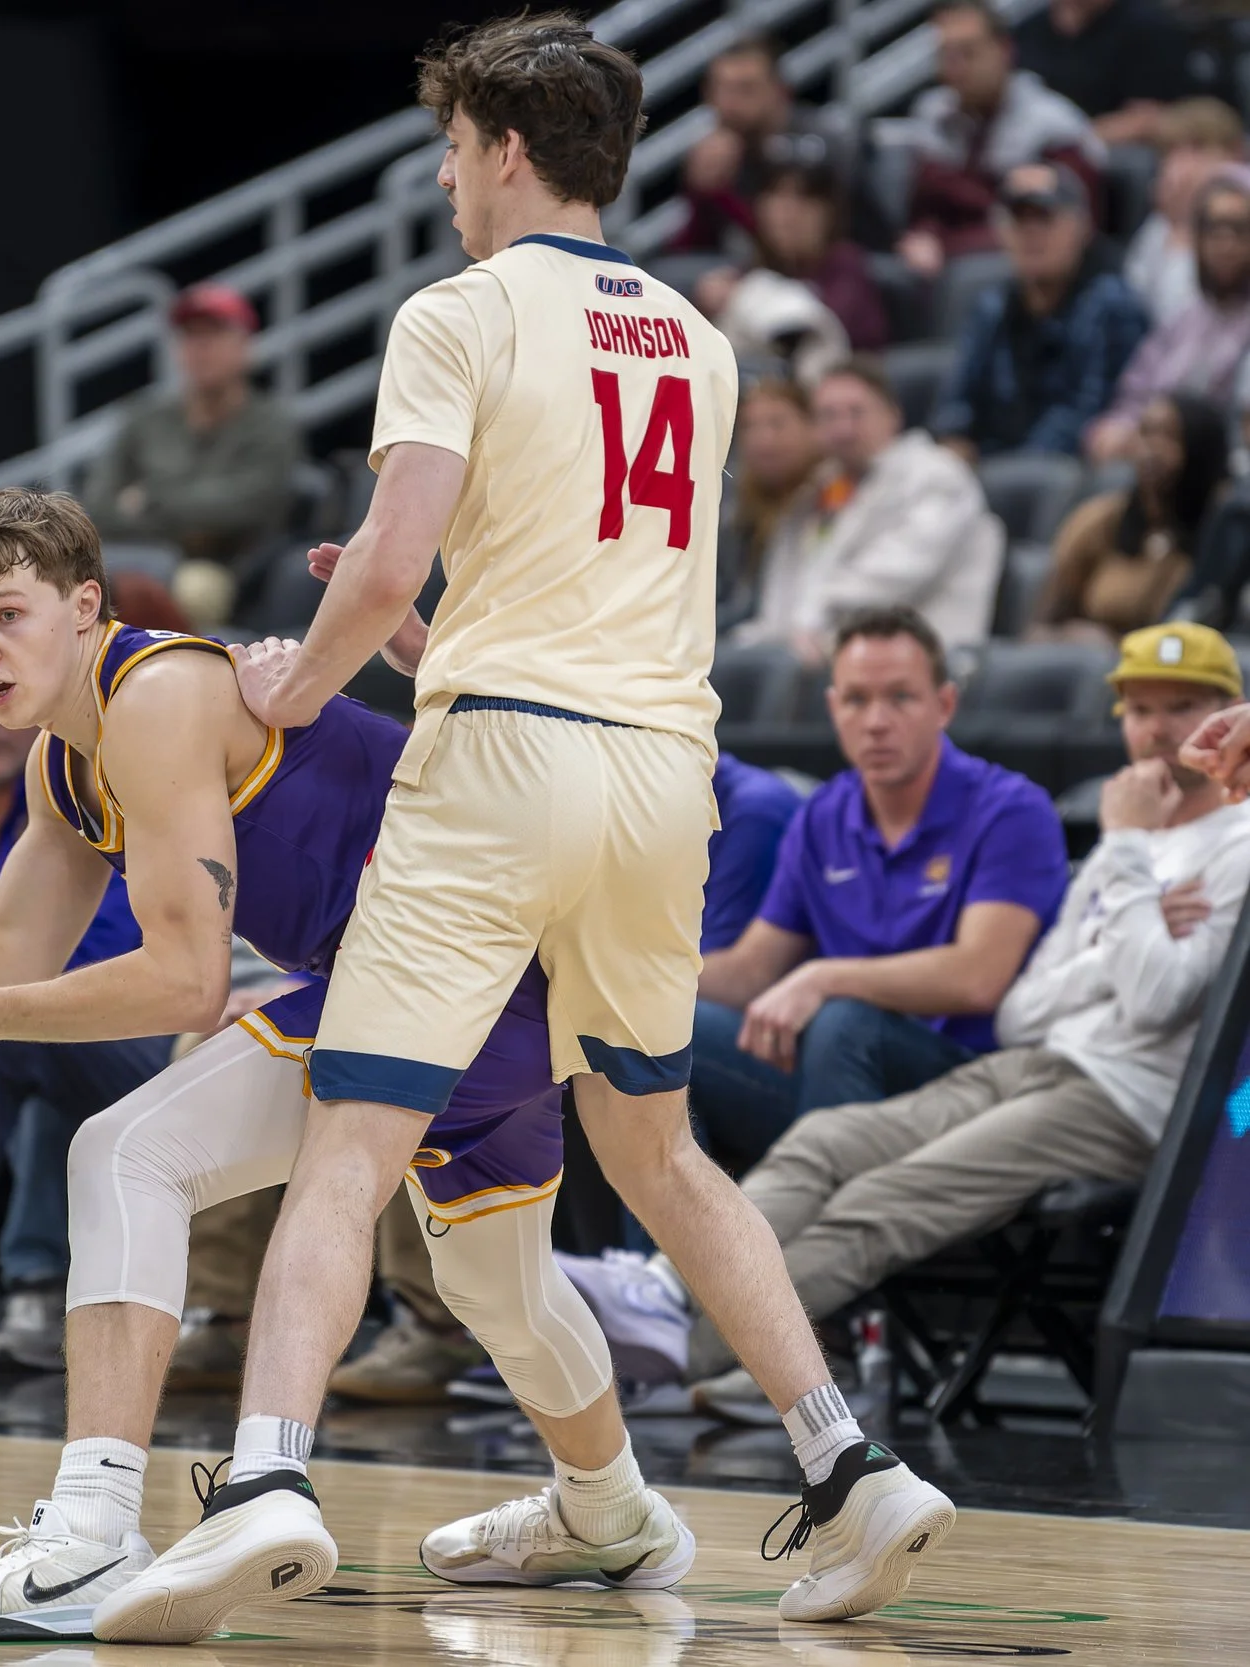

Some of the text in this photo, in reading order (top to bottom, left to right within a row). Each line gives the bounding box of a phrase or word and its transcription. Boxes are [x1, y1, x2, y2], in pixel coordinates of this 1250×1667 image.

[596, 275, 643, 297] UIC
[584, 308, 690, 359] JOHNSON
[590, 367, 695, 551] 14
